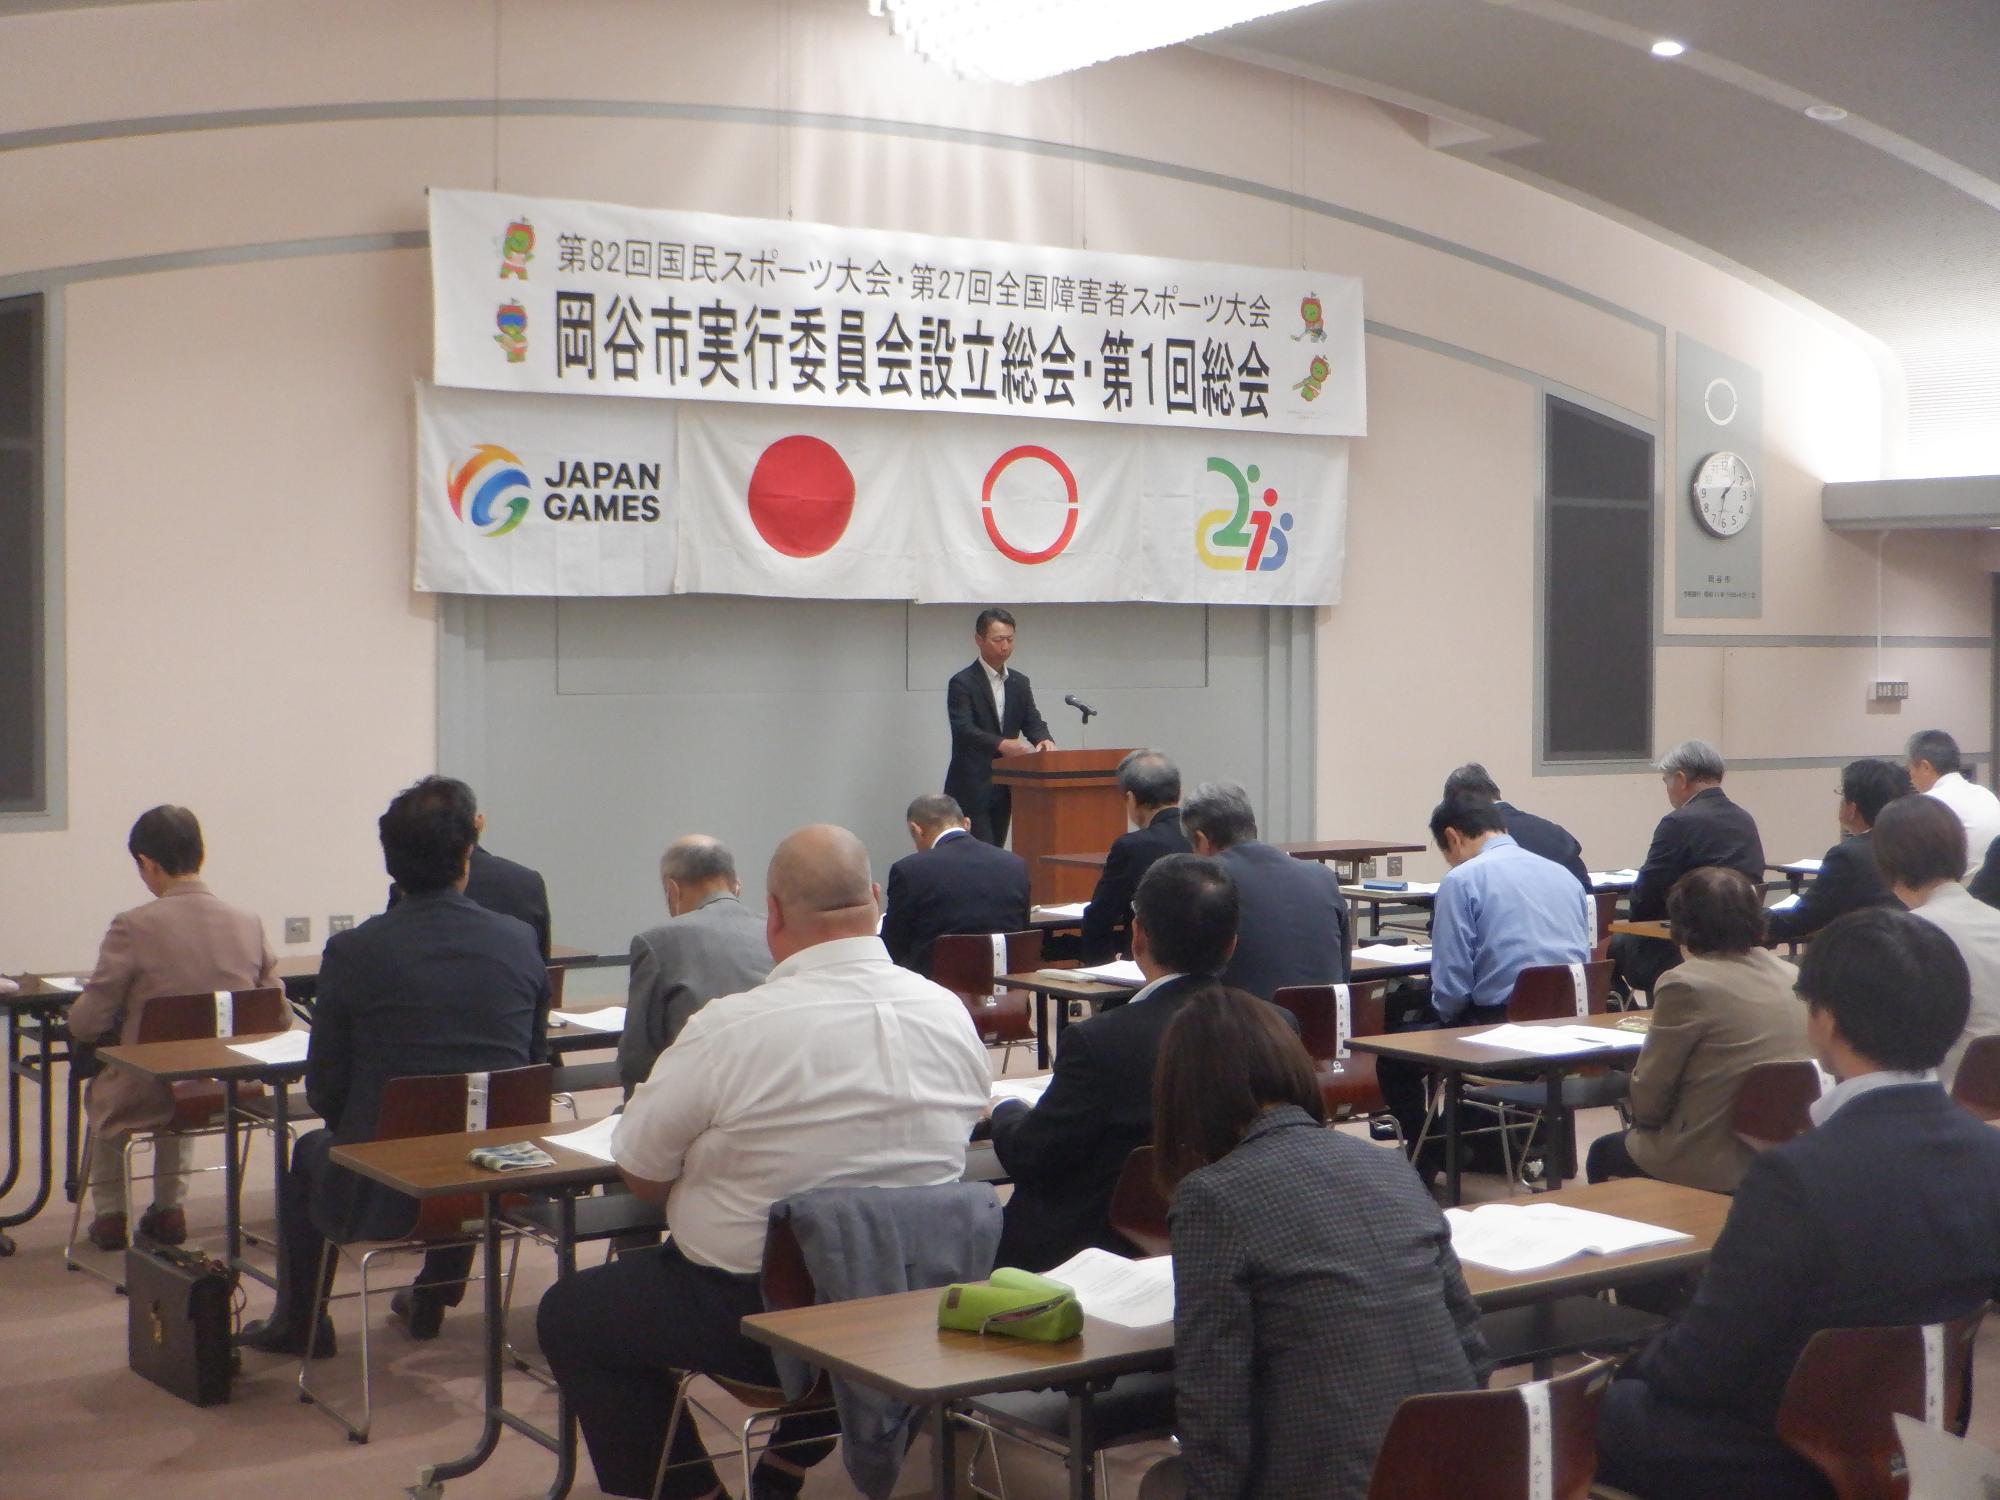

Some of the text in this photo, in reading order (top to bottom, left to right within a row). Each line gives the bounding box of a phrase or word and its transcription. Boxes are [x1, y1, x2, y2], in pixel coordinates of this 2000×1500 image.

[556, 290, 1270, 418] 岡谷市実行委員会設立総会・第1回総会
[544, 461, 661, 490] JAPAN
[1739, 476, 1744, 486] 2
[1701, 488, 1707, 498] 9
[1742, 491, 1747, 501] 3
[543, 493, 661, 522] GAMES
[1704, 503, 1709, 513] 8
[1738, 505, 1744, 514] 4
[1712, 513, 1717, 524] 7
[1721, 518, 1727, 528] 6
[1731, 515, 1737, 525] 5
